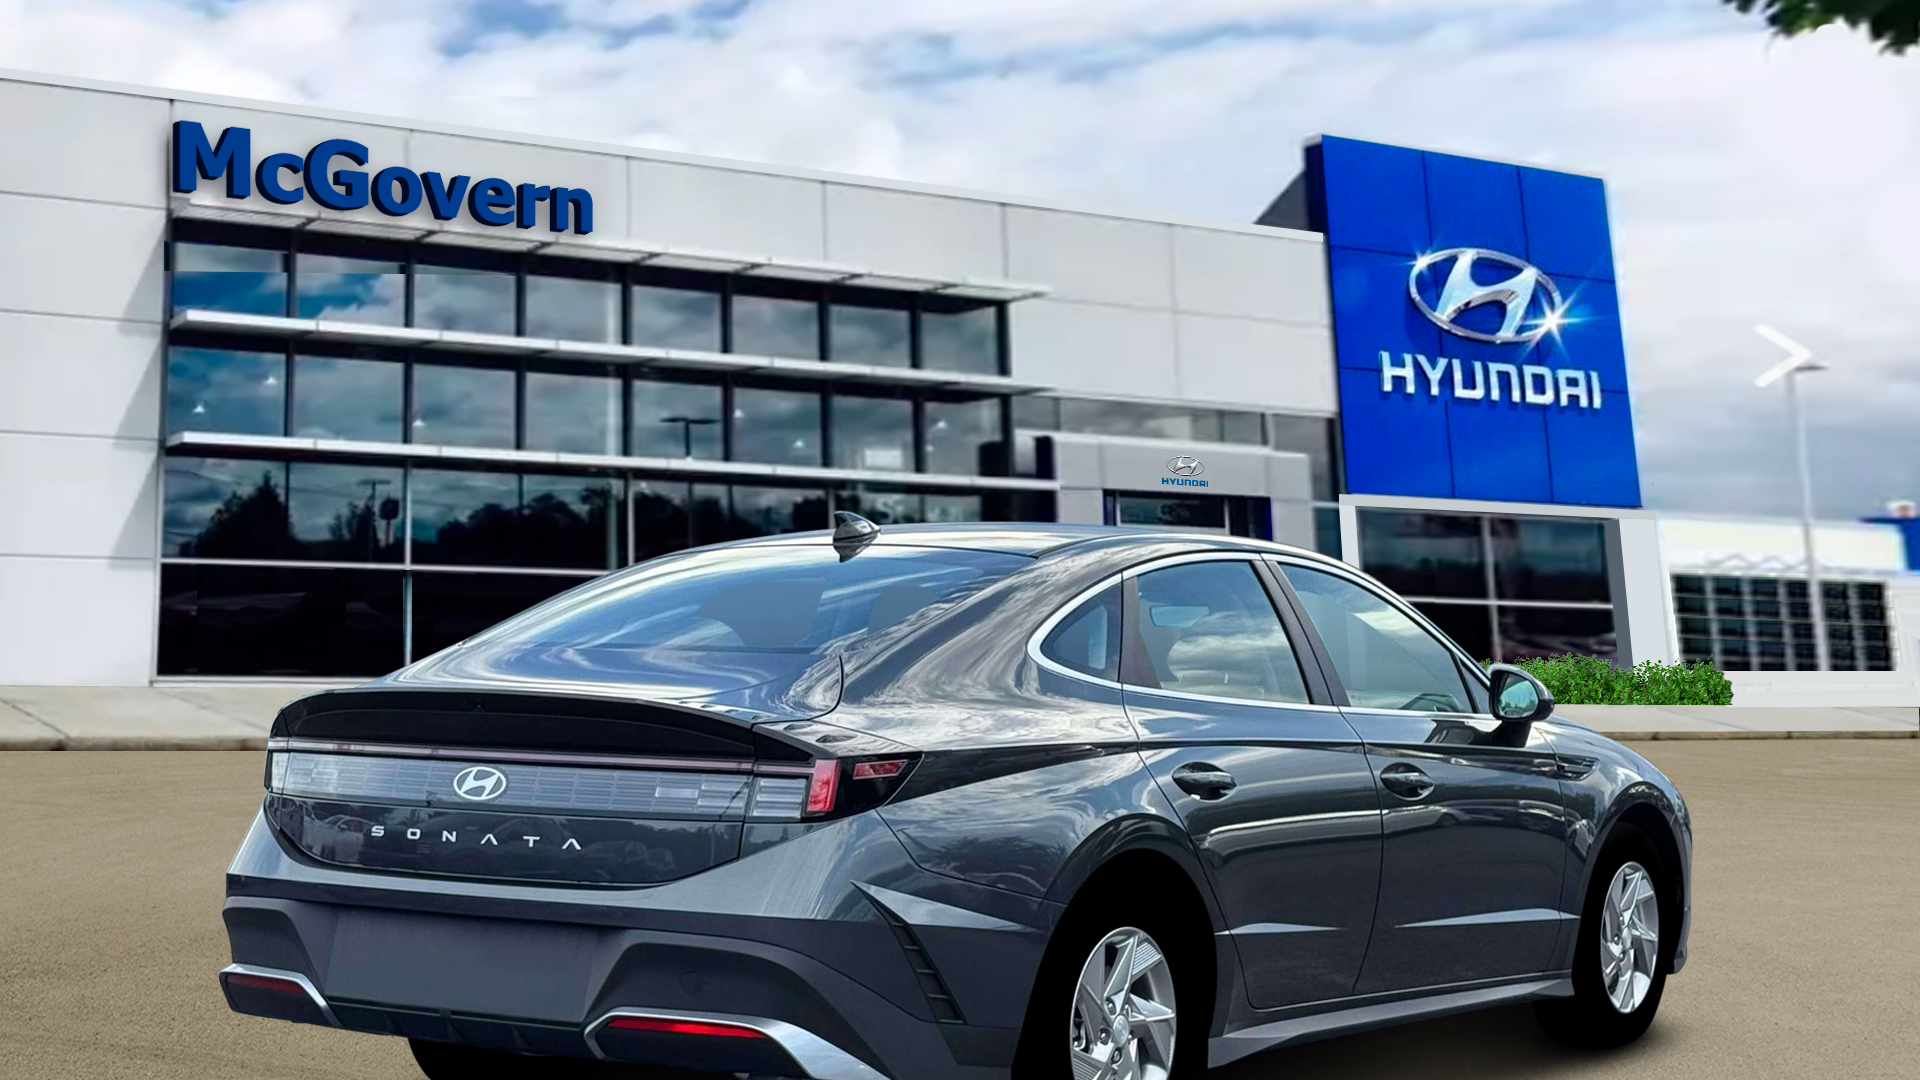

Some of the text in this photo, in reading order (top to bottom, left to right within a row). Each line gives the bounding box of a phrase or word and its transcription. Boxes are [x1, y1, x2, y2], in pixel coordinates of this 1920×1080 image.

[172, 120, 593, 235] McGovern
[1379, 351, 1601, 409] HYUNDAI
[1161, 477, 1209, 488] HYUNDAI
[370, 825, 582, 850] SONATA
